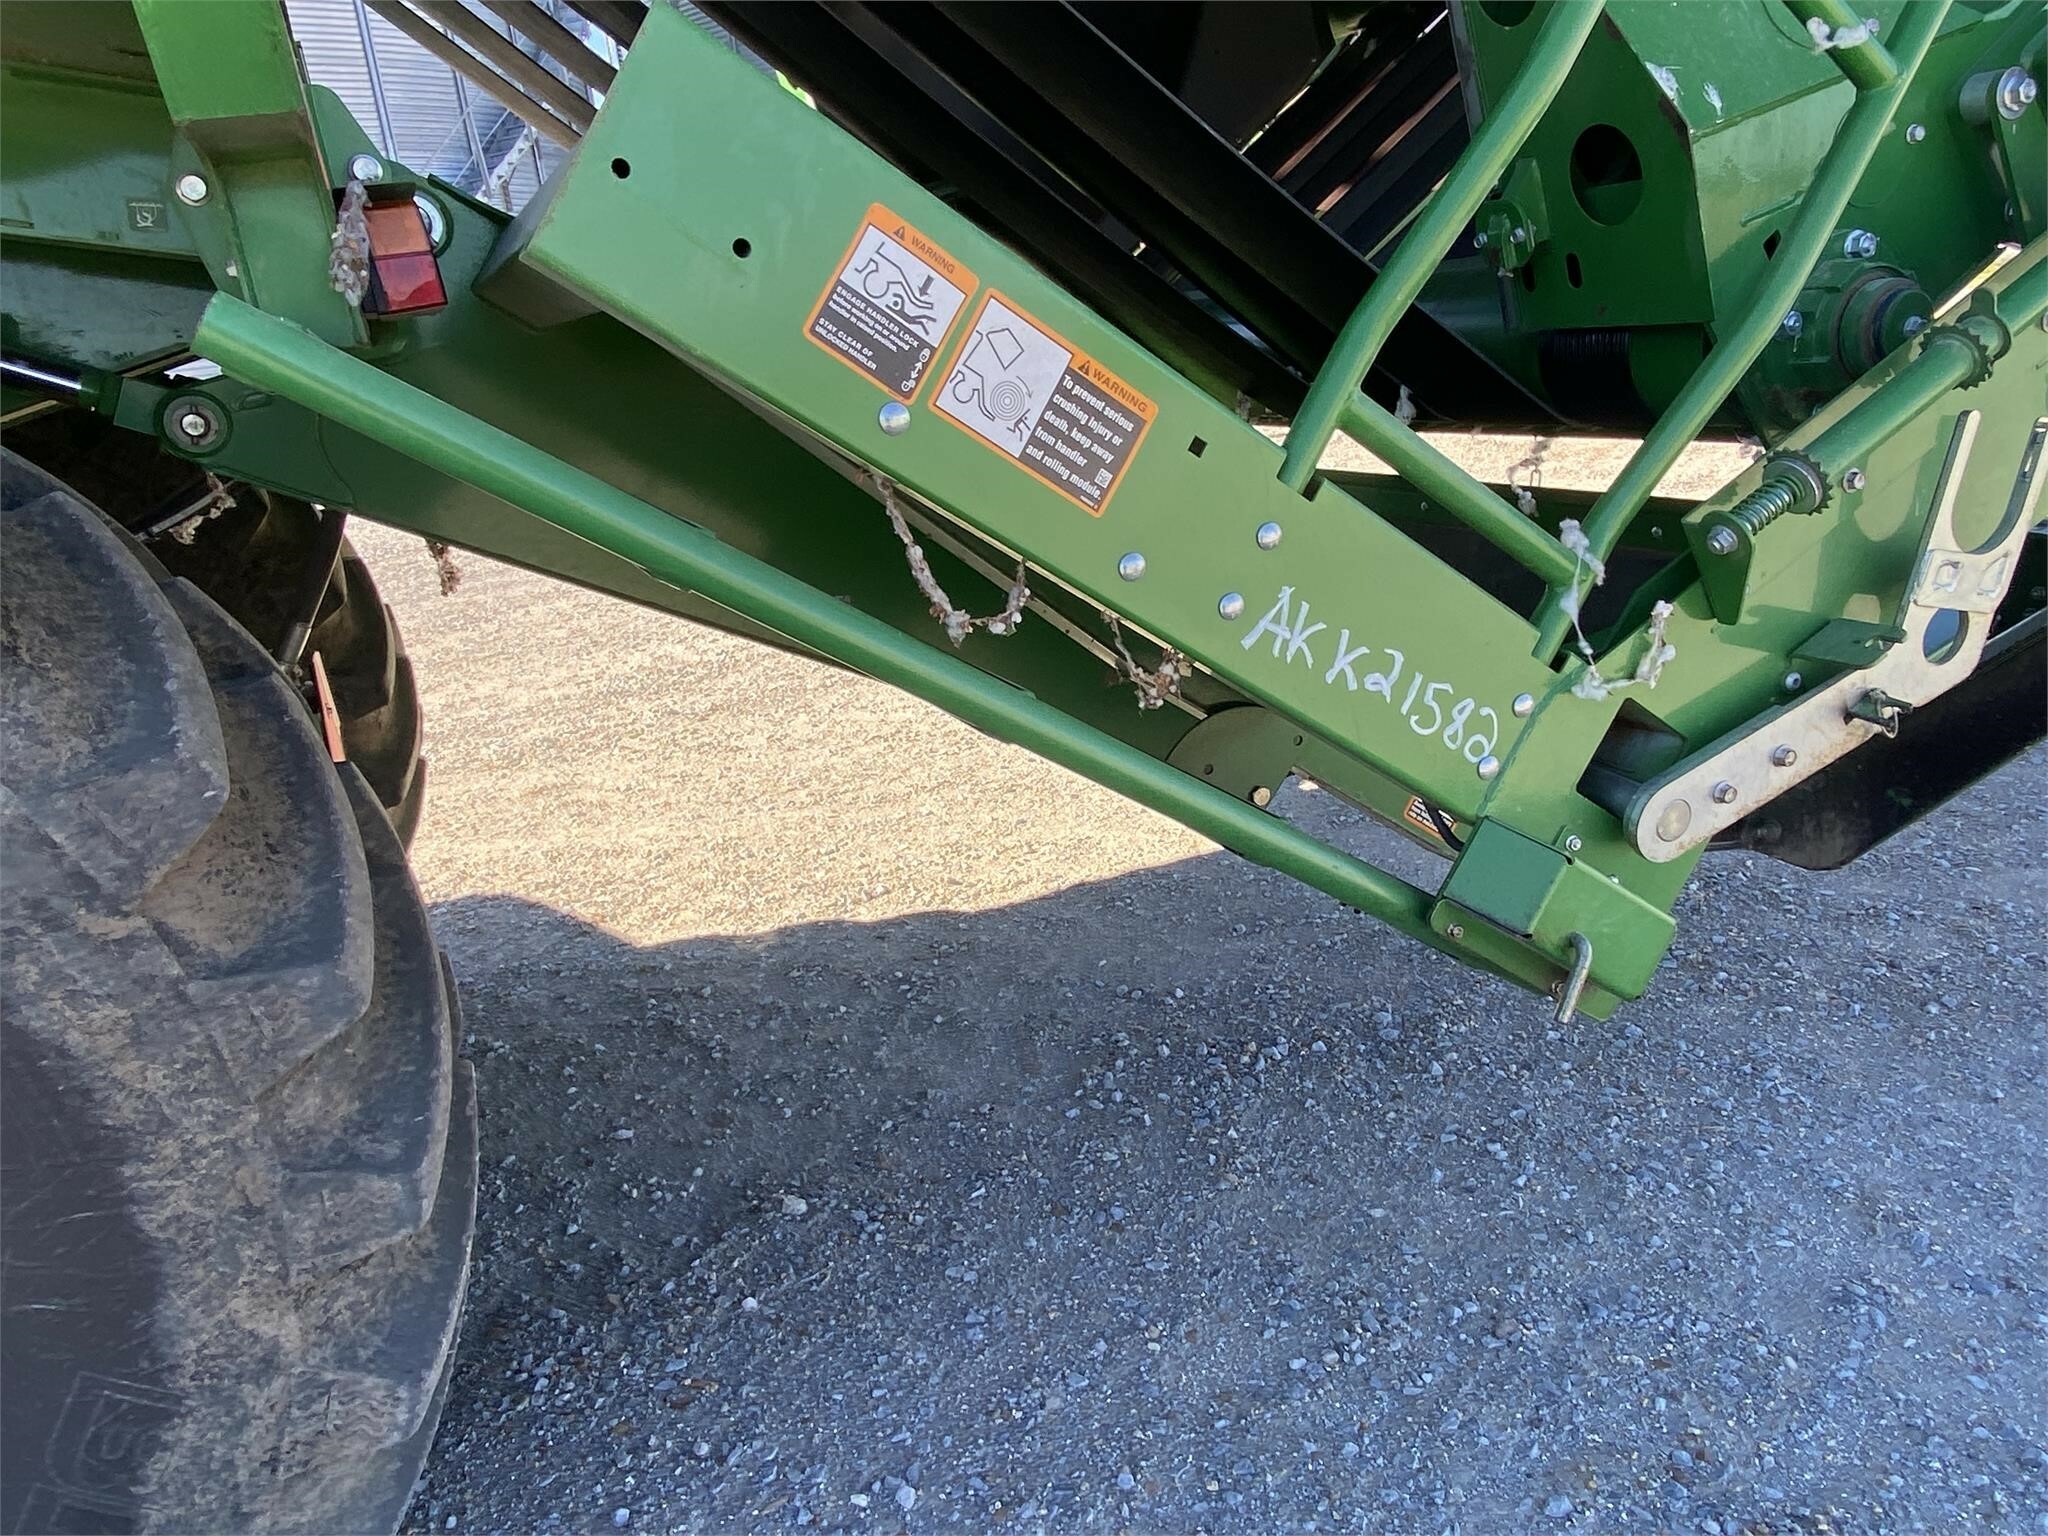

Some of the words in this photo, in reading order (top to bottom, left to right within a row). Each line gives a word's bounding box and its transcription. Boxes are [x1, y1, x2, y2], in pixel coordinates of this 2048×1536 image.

[909, 236, 956, 274] WARNING
[828, 300, 850, 318] handler
[850, 315, 856, 323] in
[832, 293, 851, 309] before
[850, 306, 874, 326] working
[874, 323, 882, 331] on
[889, 333, 909, 350] around
[836, 285, 866, 309] ENGAGE
[866, 307, 898, 332] HANDLER
[899, 331, 919, 347] LOCK
[815, 324, 848, 350] UNLOCKED
[848, 347, 876, 370] HANDLER
[818, 317, 836, 333] STAY
[837, 330, 861, 350] CLEAR
[862, 347, 872, 357] OF
[1061, 374, 1074, 389] To
[1071, 383, 1105, 412] prevent
[1103, 404, 1135, 432] serious
[1091, 370, 1147, 413] WARNING
[1043, 409, 1071, 434] death,
[1069, 427, 1092, 450] keep
[1090, 442, 1114, 464] away
[1051, 392, 1089, 424] crushing
[1087, 416, 1114, 441] injury
[1111, 435, 1122, 446] or
[1034, 425, 1056, 446] from
[1054, 439, 1088, 467] handler
[1025, 443, 1043, 460] and
[1041, 453, 1071, 480] rolling
[1069, 472, 1104, 500] module.
